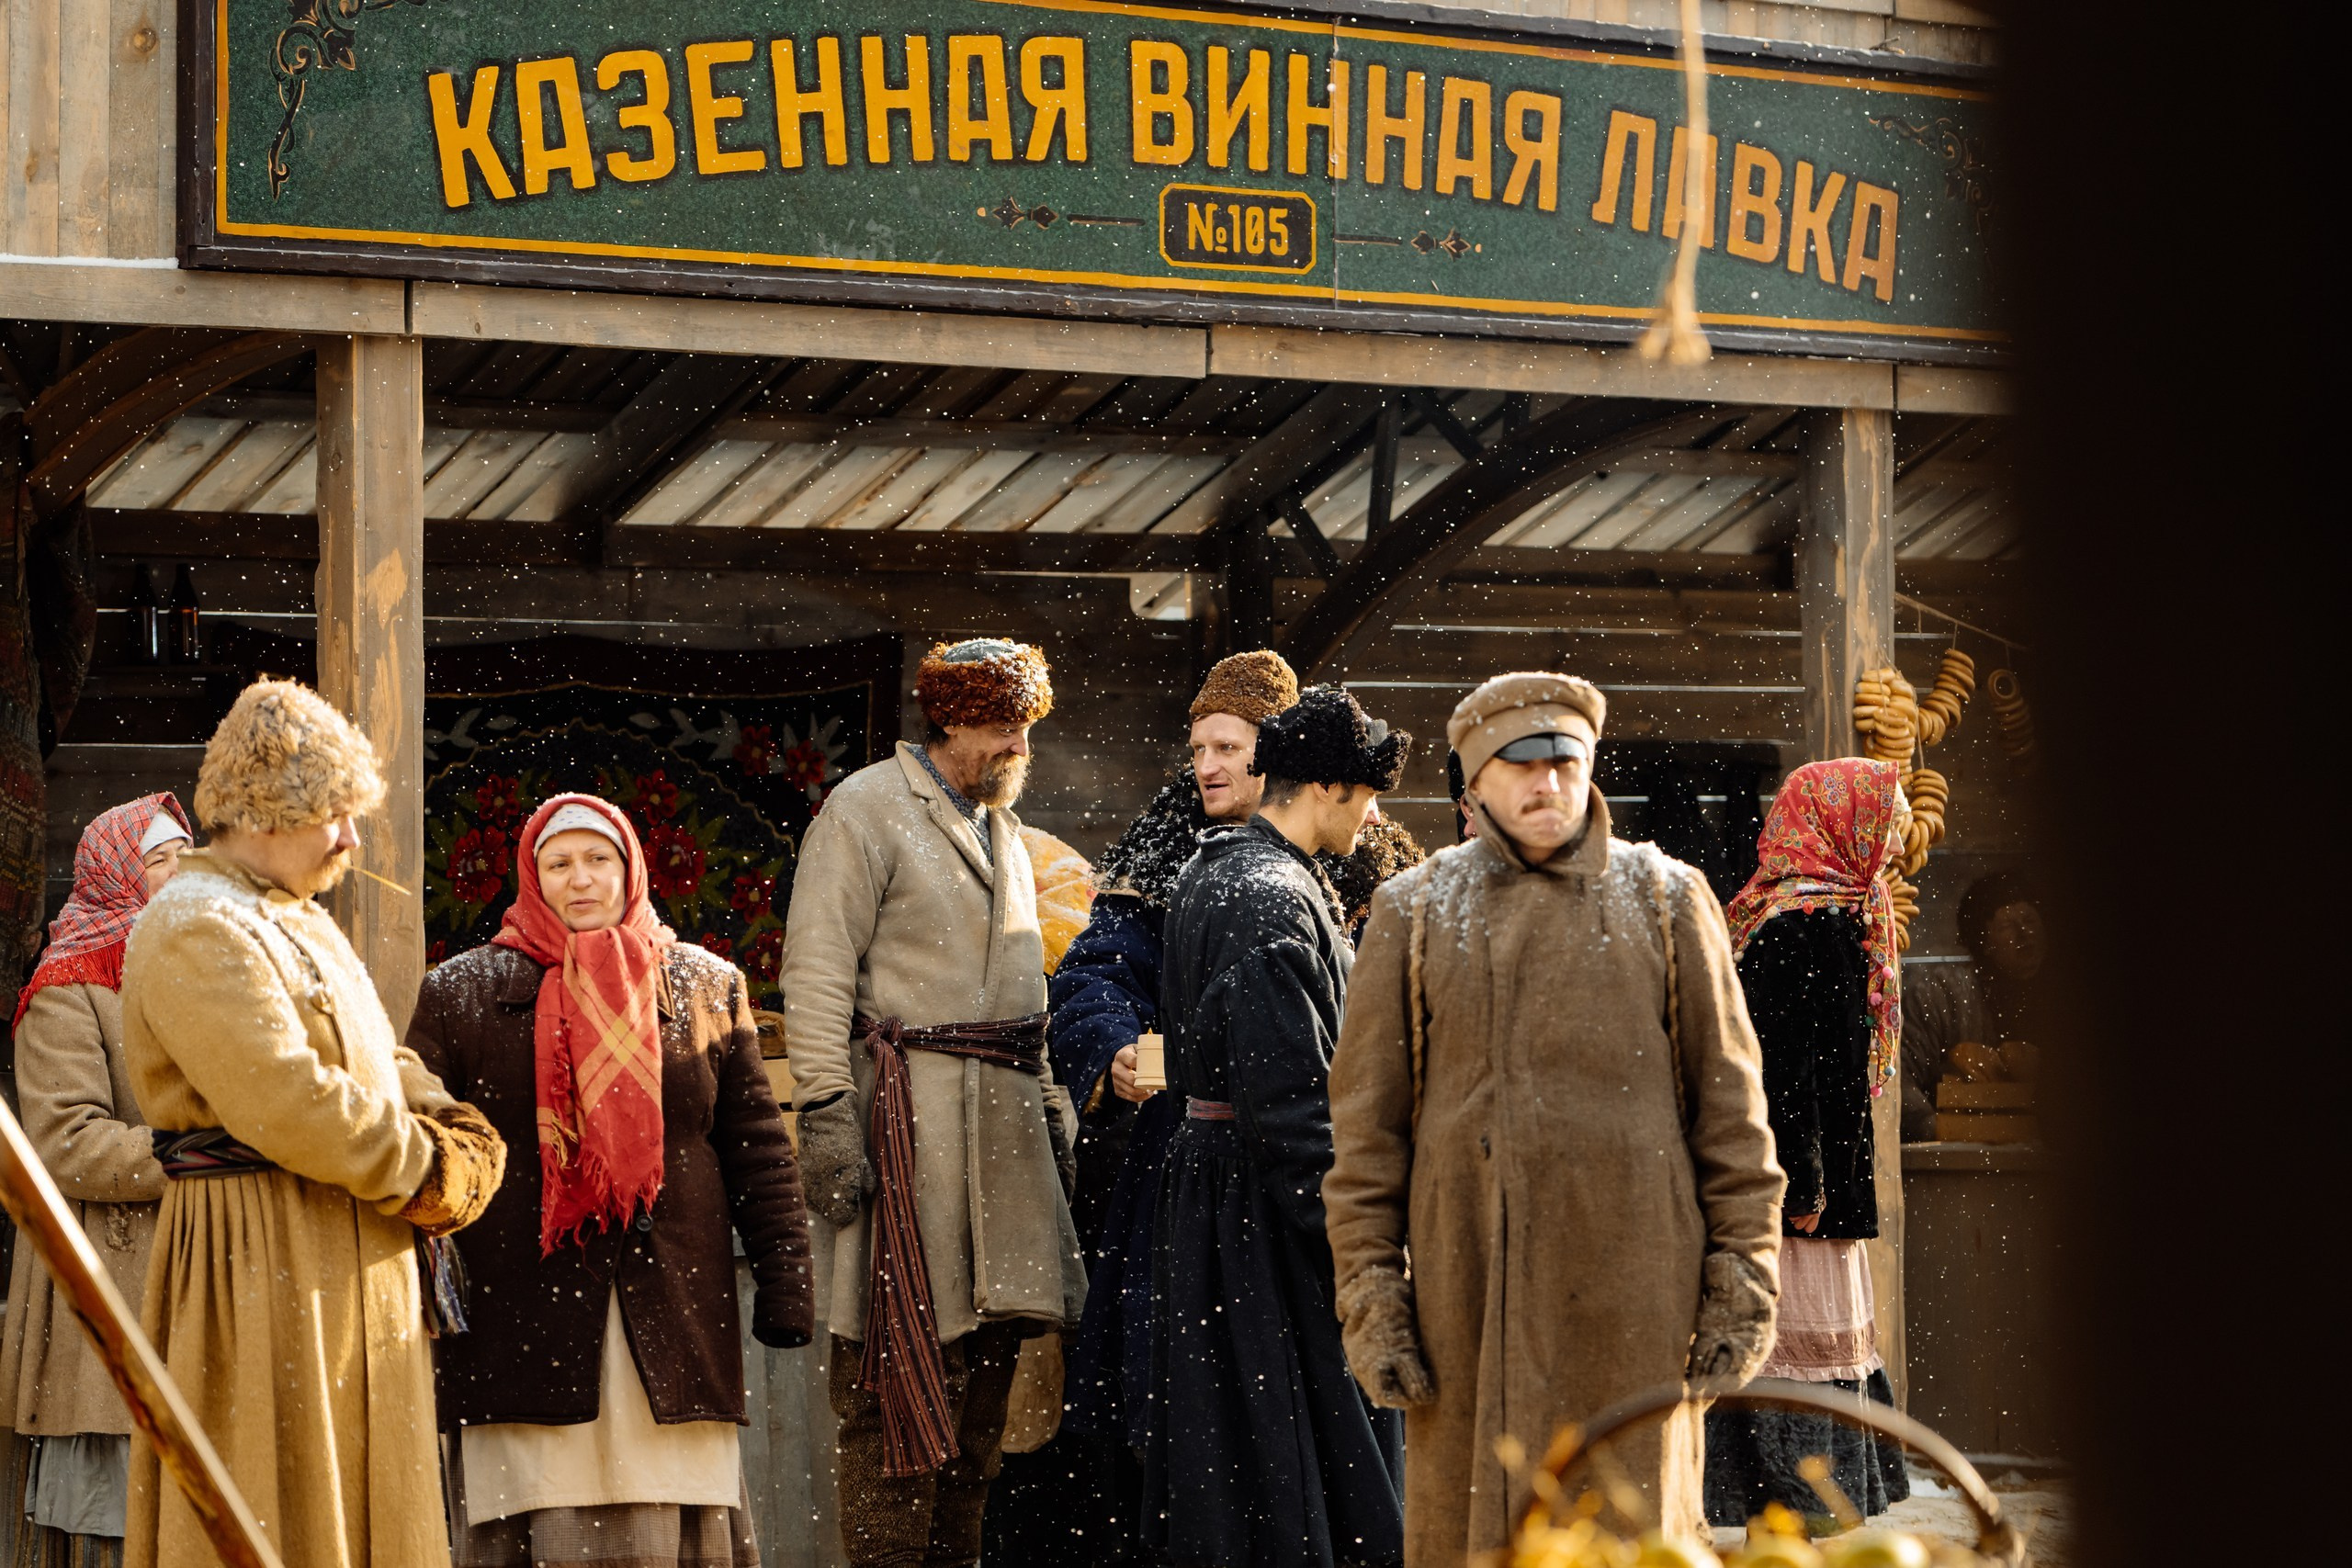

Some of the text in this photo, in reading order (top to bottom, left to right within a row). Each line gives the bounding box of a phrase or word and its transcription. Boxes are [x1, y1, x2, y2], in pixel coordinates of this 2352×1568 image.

[428, 35, 1087, 209] КАЗЕННАЯ
[1131, 39, 1561, 212] ВИННАЯ
[1187, 202, 1289, 256] №105
